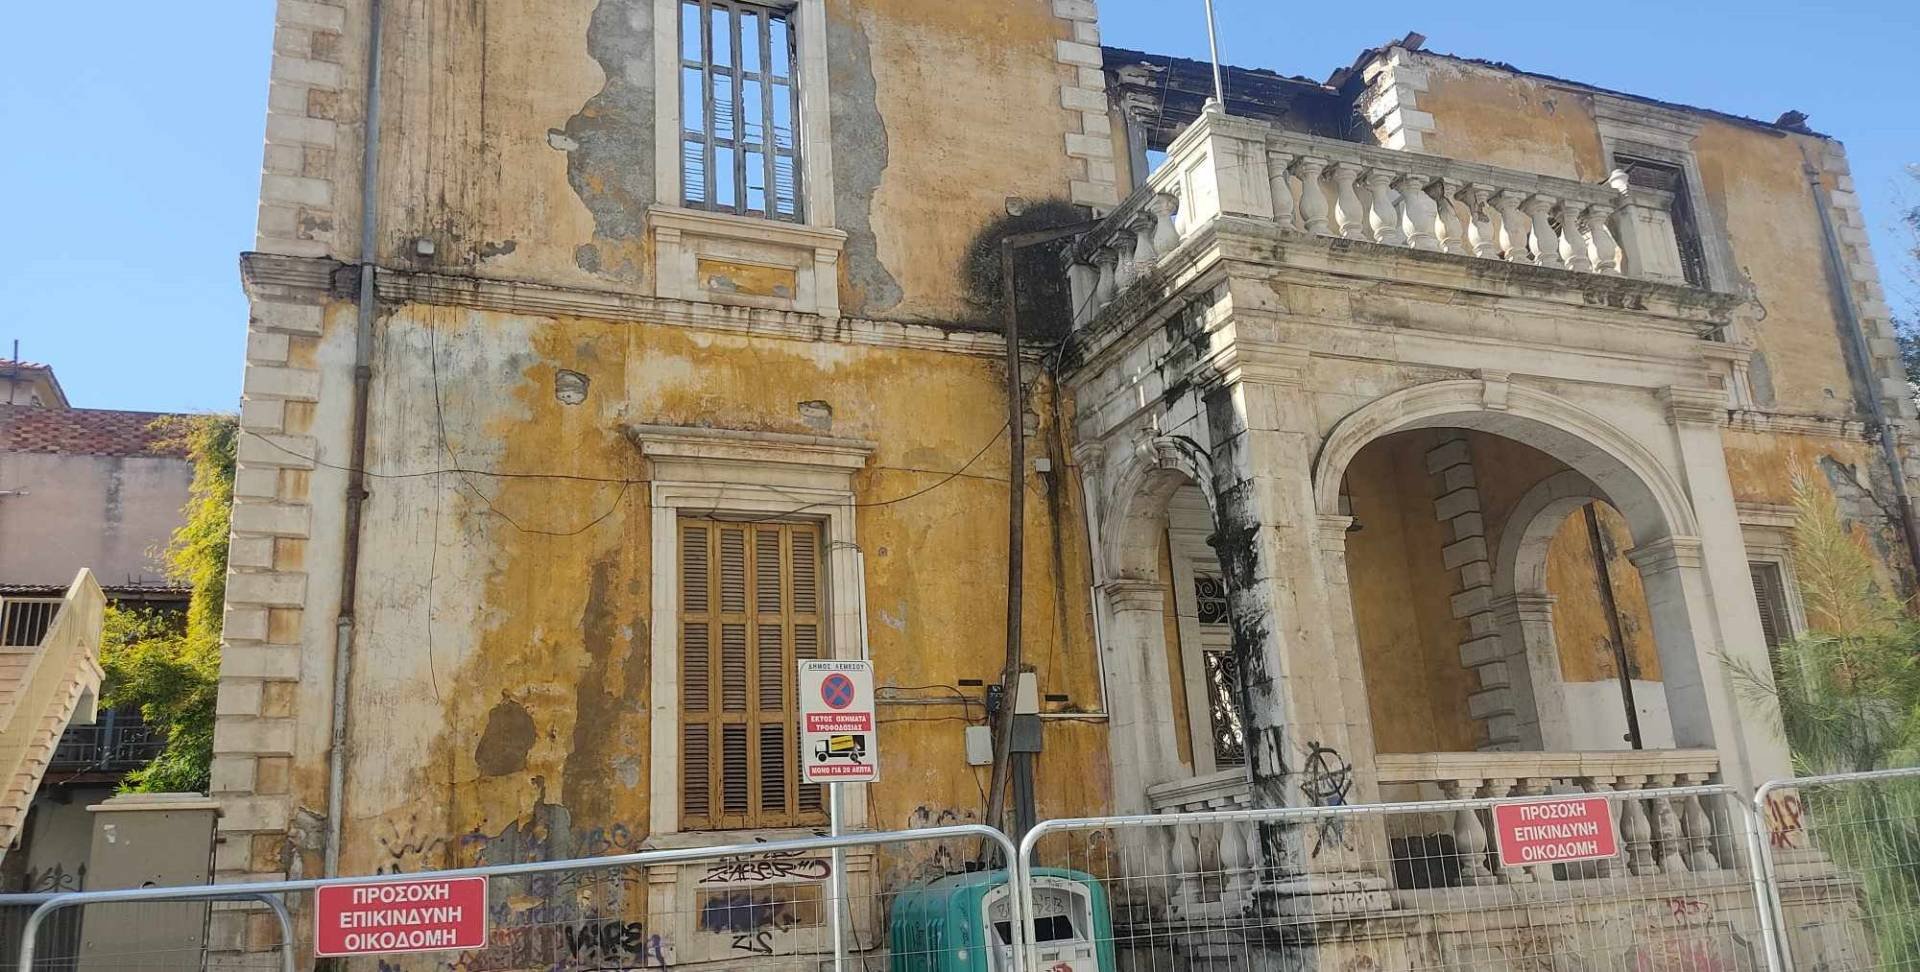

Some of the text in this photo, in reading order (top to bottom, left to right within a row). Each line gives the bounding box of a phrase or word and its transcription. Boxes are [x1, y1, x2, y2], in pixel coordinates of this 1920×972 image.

[810, 715, 833, 723] ΕΚΤΟΣ
[1520, 803, 1587, 821] ΠΡΟΣΟΧΗ
[1514, 821, 1599, 841] ΕΠΙΚΙΝΔΥΝΗ
[1522, 840, 1599, 861] ΟΙΚΟΔΟΜΗ
[353, 883, 449, 904] ΠΡΟΣΟΧΗ
[340, 906, 462, 928] ΕΠΙΚΙΝΔΥΝΗ
[345, 929, 457, 950] ΟΙΚΟΔΟΜΗ
